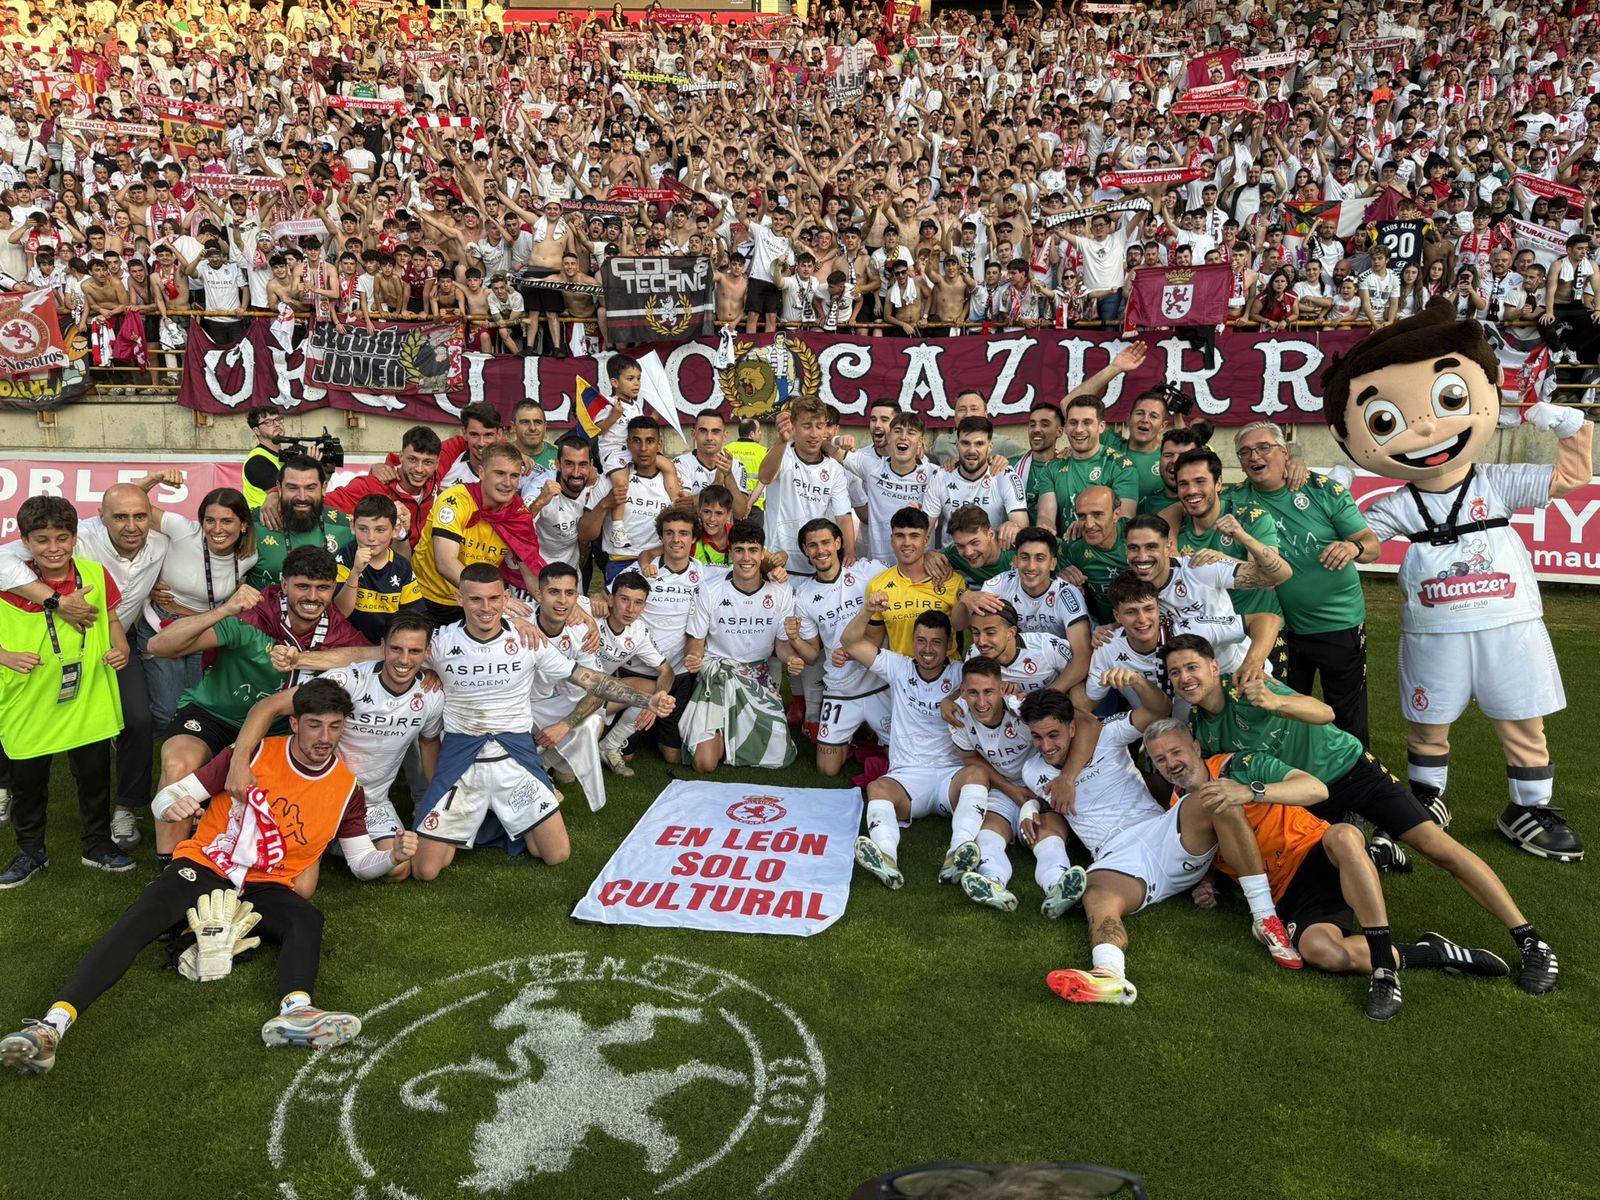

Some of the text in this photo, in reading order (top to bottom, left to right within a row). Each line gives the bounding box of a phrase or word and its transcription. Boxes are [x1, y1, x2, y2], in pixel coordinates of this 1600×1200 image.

[75, 121, 104, 130] FRENTE
[1121, 176, 1153, 185] ORGULLO
[1383, 231, 1415, 259] 20
[876, 480, 927, 494] ASPIRE
[881, 491, 920, 501] ACADEMY
[945, 496, 989, 508] ASPRE
[1527, 550, 1600, 569] mau
[1424, 578, 1508, 600] Manzer
[357, 591, 399, 603] SPIRE
[718, 617, 774, 626] ASPIRE
[1016, 613, 1057, 624] SPIRE
[444, 661, 522, 676] ASPIRE
[453, 678, 511, 688] ACADEMY
[822, 701, 842, 725] 31
[346, 712, 422, 729] ASPIRE
[351, 724, 407, 737] ACADEMY
[975, 743, 1027, 758] APIRE
[655, 825, 829, 856] EN LEÓN
[671, 851, 787, 883] SOLO
[597, 879, 830, 921] CULTURAL
[201, 927, 224, 937] SP
